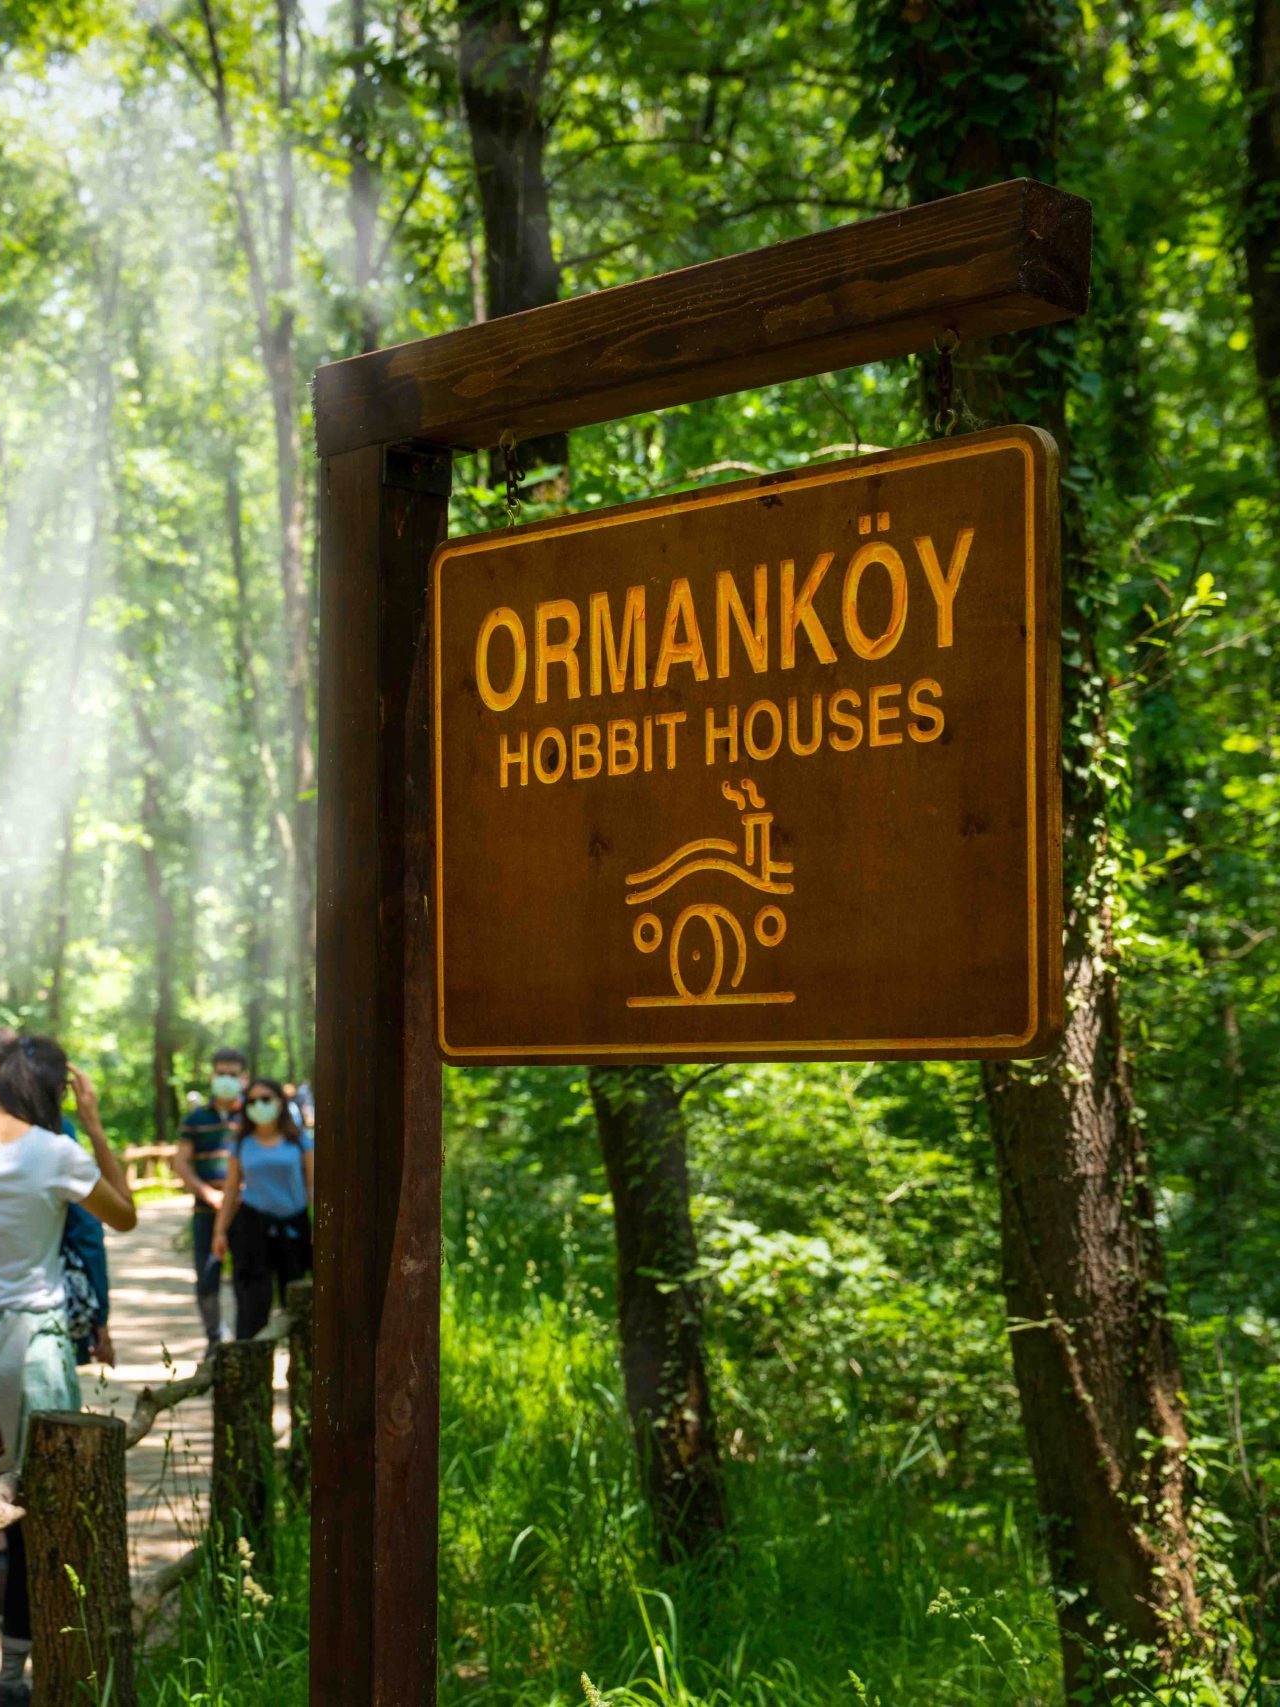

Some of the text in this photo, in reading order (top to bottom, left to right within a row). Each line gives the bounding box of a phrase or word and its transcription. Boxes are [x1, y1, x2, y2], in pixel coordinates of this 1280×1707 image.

[475, 511, 975, 712] ORMANKÖY
[499, 678, 945, 788] HOBBIT HOUSES
